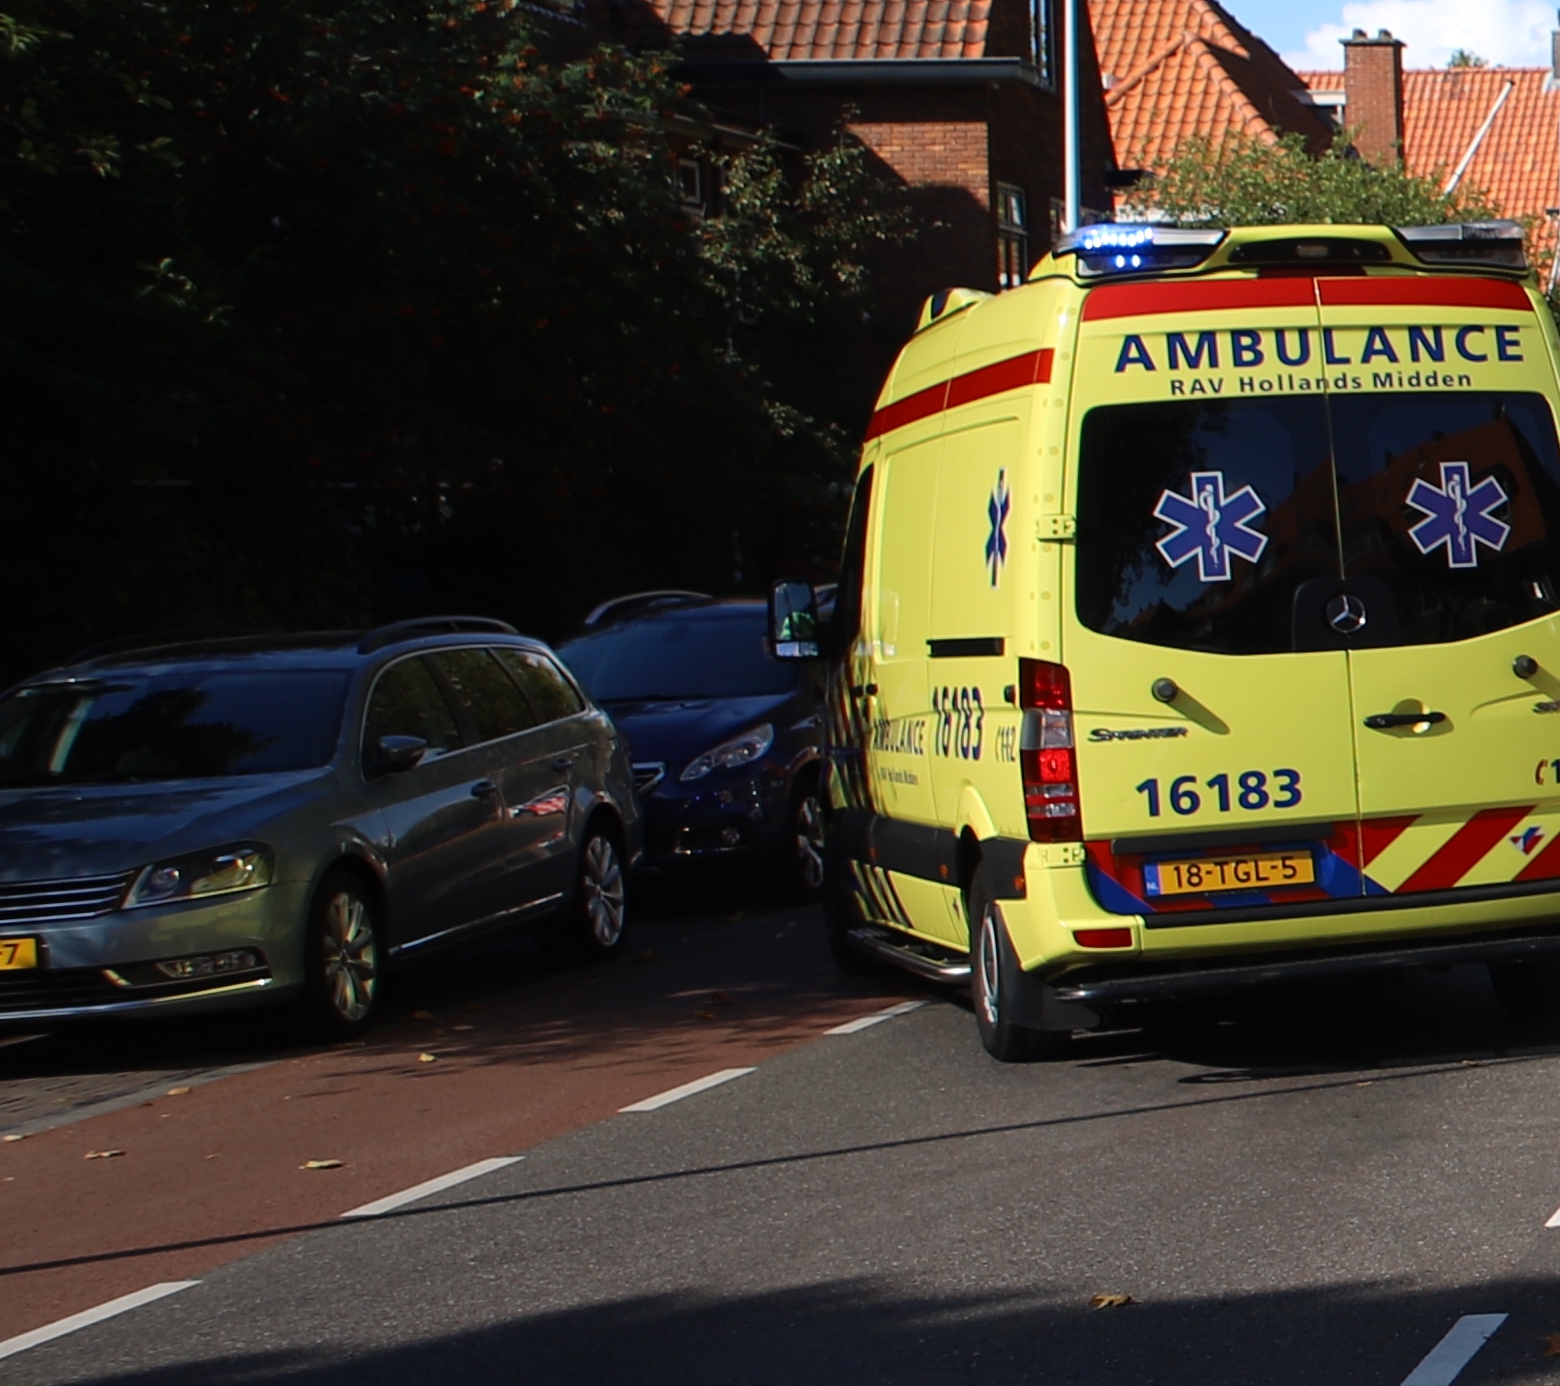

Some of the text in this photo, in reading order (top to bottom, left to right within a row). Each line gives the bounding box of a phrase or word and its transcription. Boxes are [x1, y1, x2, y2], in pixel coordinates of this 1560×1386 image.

[1114, 325, 1525, 373] AMBULANCE
[1170, 370, 1473, 396] RAV Hollands Midden
[932, 685, 986, 762] 16183
[1135, 768, 1303, 818] 16183
[1173, 856, 1298, 889] 18-TGL-5
